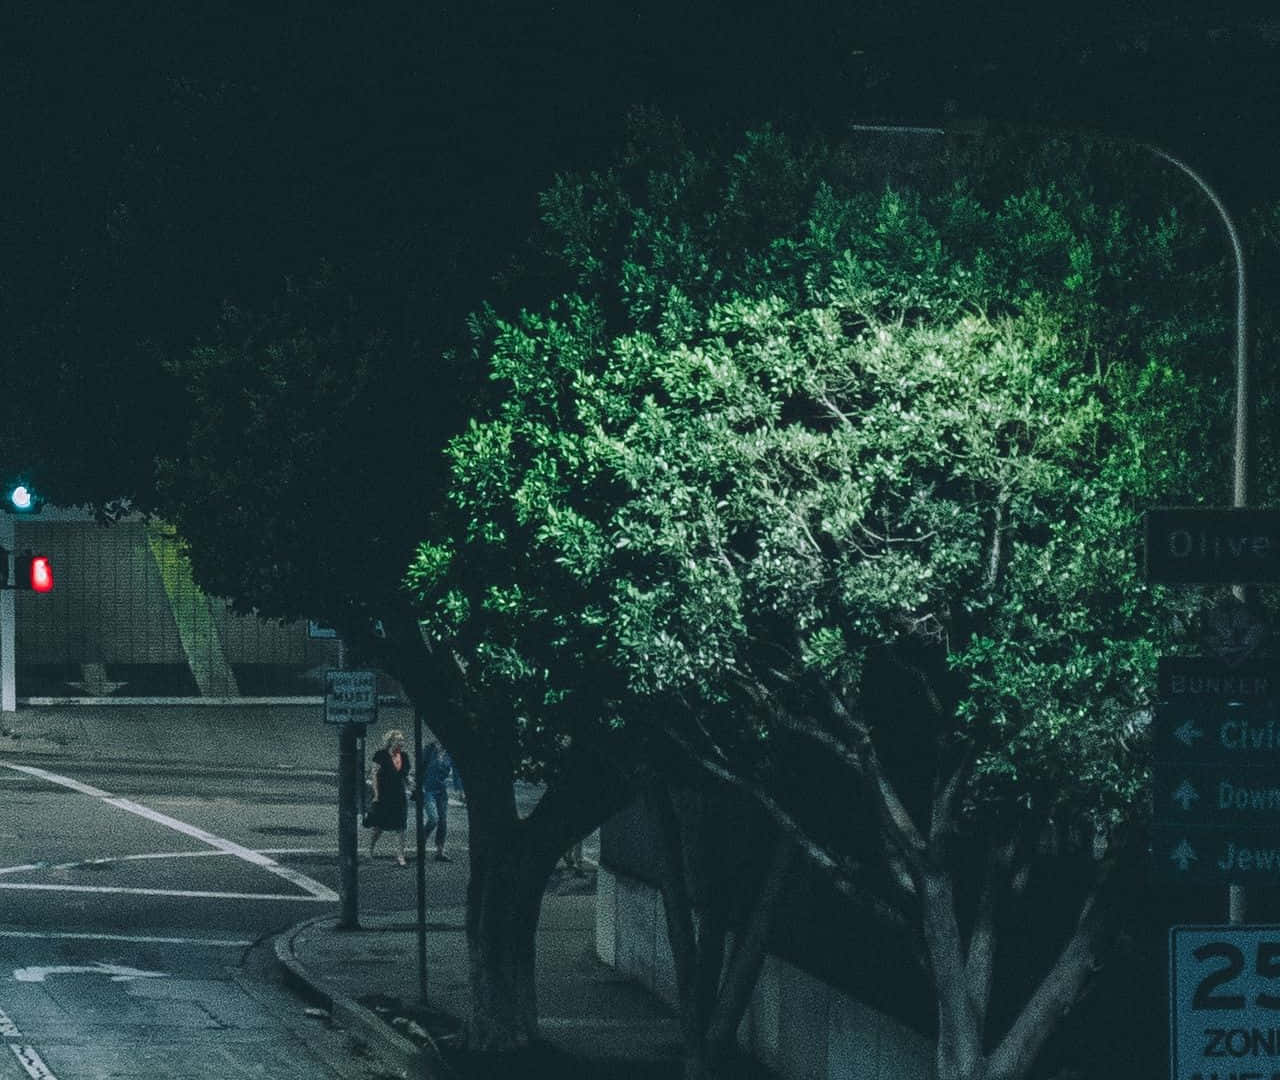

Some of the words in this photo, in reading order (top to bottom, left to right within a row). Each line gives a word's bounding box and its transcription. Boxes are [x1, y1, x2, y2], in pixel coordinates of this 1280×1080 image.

[1167, 528, 1272, 557] Olive
[1219, 720, 1280, 749] Civi
[1217, 840, 1280, 871] Jew
[1203, 1028, 1280, 1057] ZON
